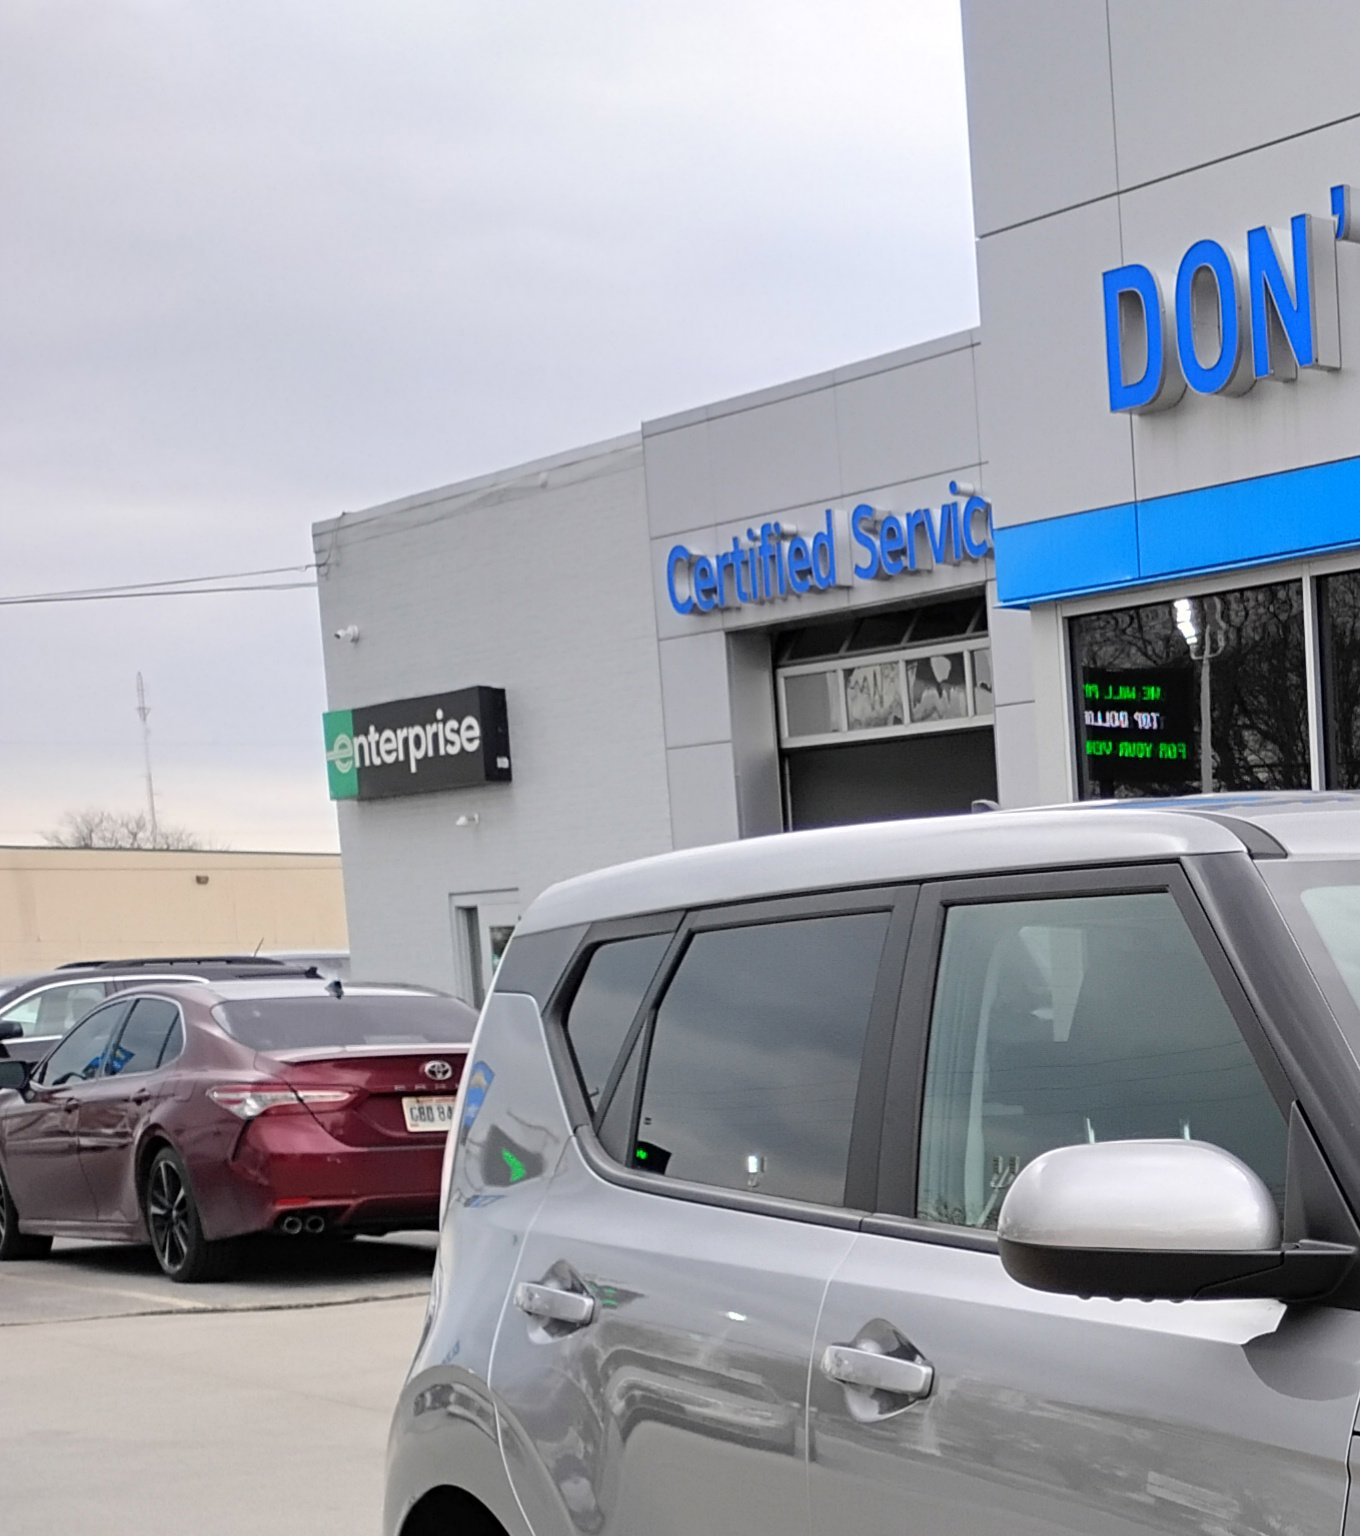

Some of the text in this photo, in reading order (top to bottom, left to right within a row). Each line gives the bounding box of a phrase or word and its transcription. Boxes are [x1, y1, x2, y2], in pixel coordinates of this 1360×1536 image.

[666, 480, 993, 615] Certified Servic
[326, 708, 481, 774] enterprise
